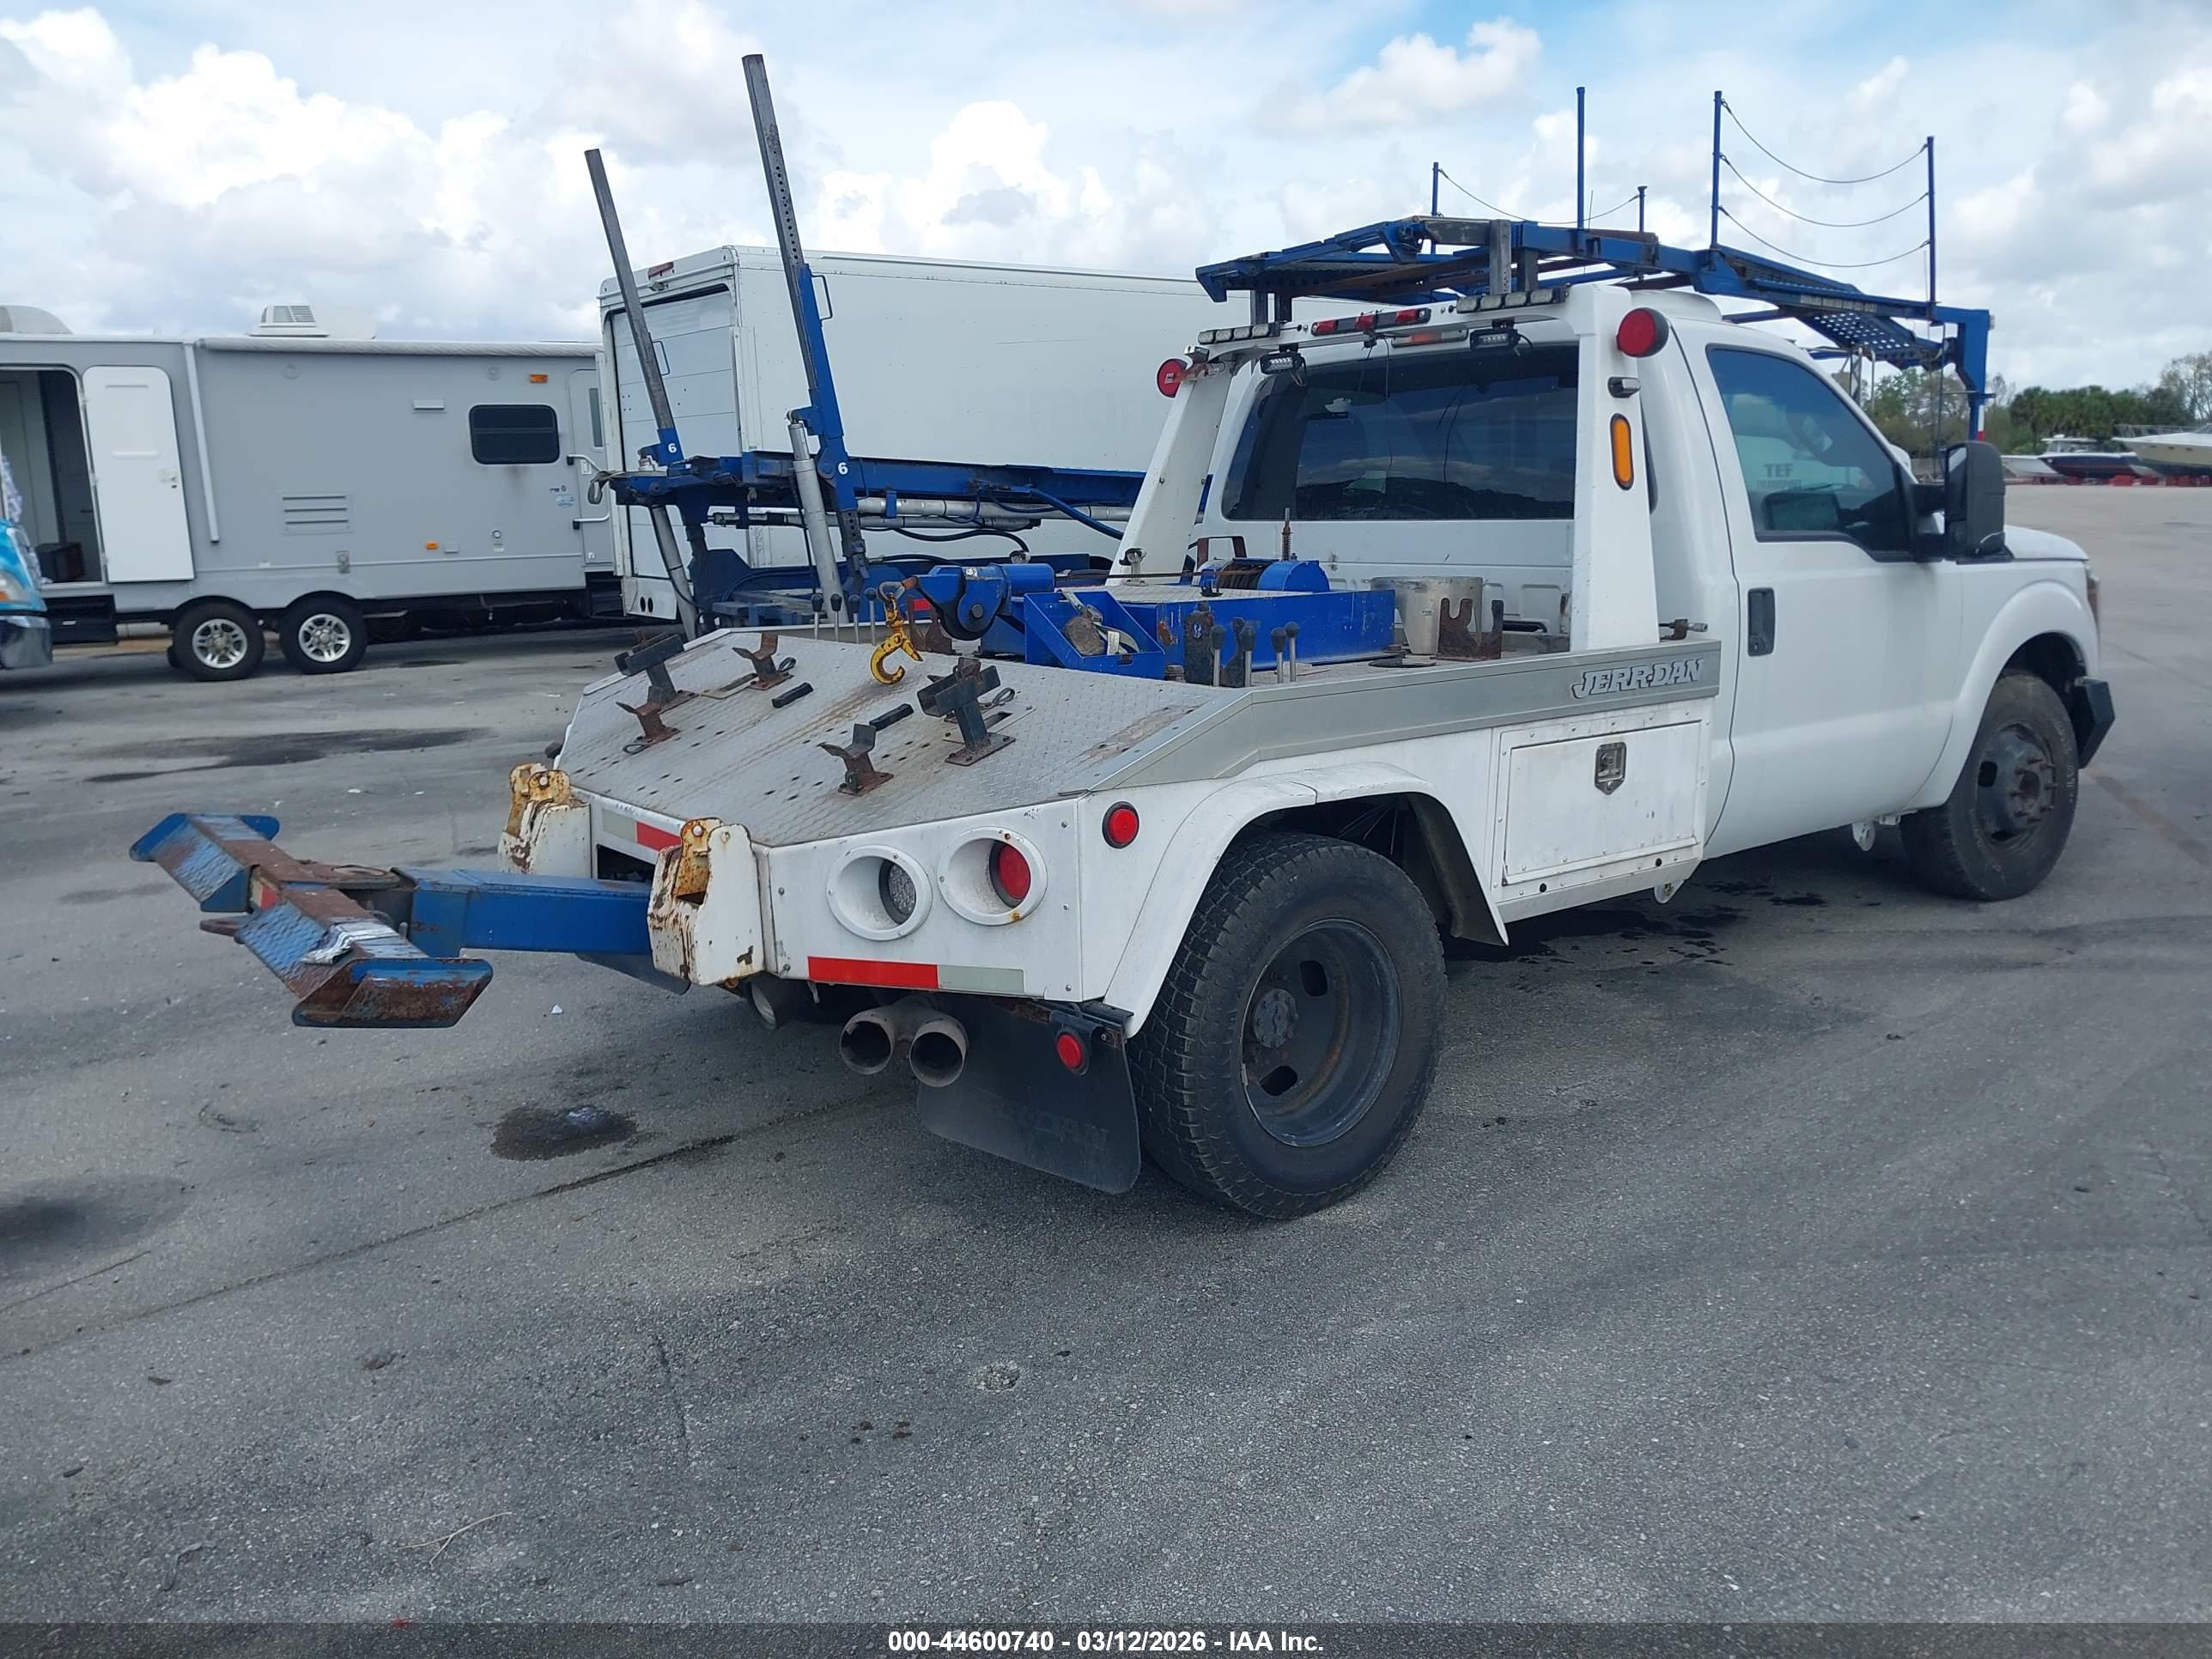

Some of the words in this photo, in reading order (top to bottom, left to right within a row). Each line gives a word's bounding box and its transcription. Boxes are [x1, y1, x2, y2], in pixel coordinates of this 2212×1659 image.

[667, 442, 678, 453] 6
[837, 461, 848, 475] 6
[1763, 463, 1794, 477] TEF
